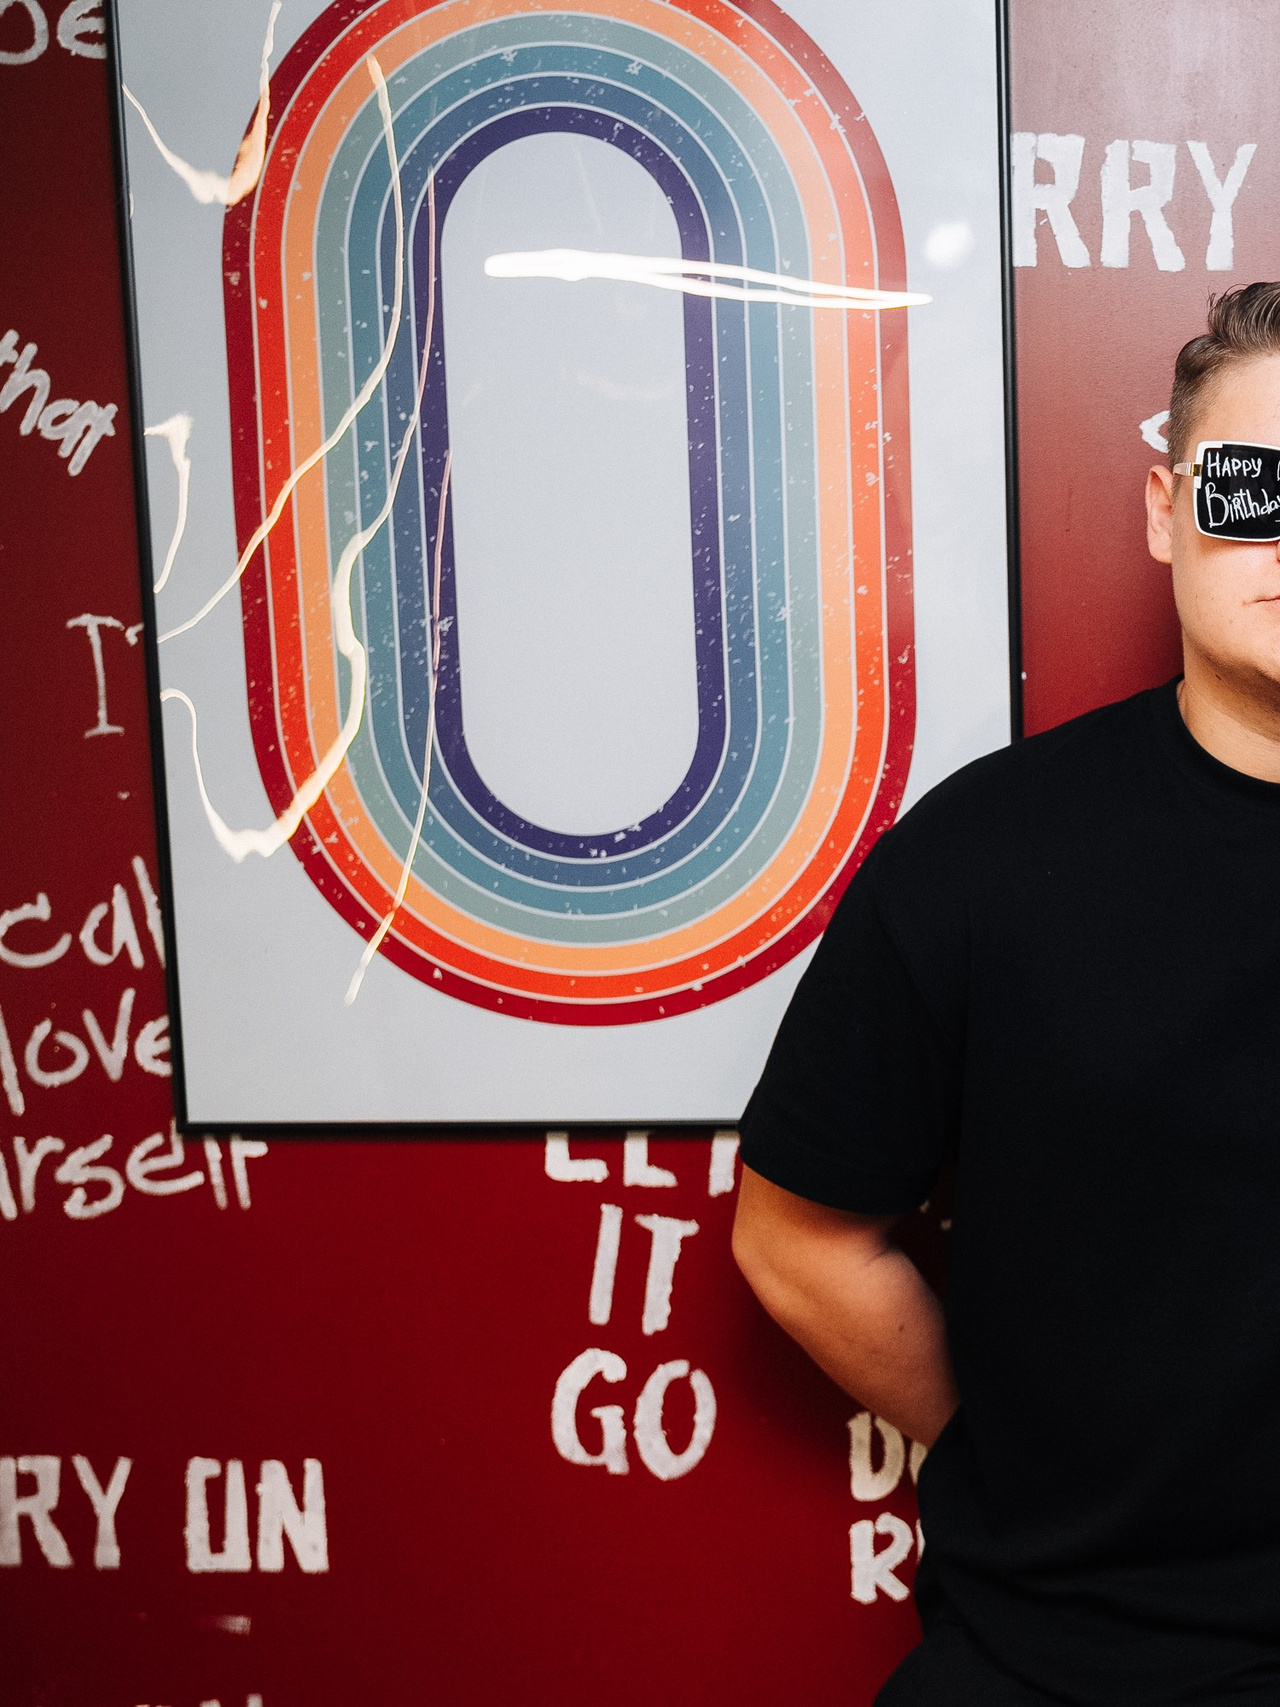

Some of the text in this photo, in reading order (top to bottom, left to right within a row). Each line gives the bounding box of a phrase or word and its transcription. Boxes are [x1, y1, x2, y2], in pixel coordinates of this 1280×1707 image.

[1207, 451, 1262, 478] HAPPY
[588, 1203, 699, 1336] IT
[551, 1347, 717, 1481] GO
[184, 1456, 330, 1574] ON
